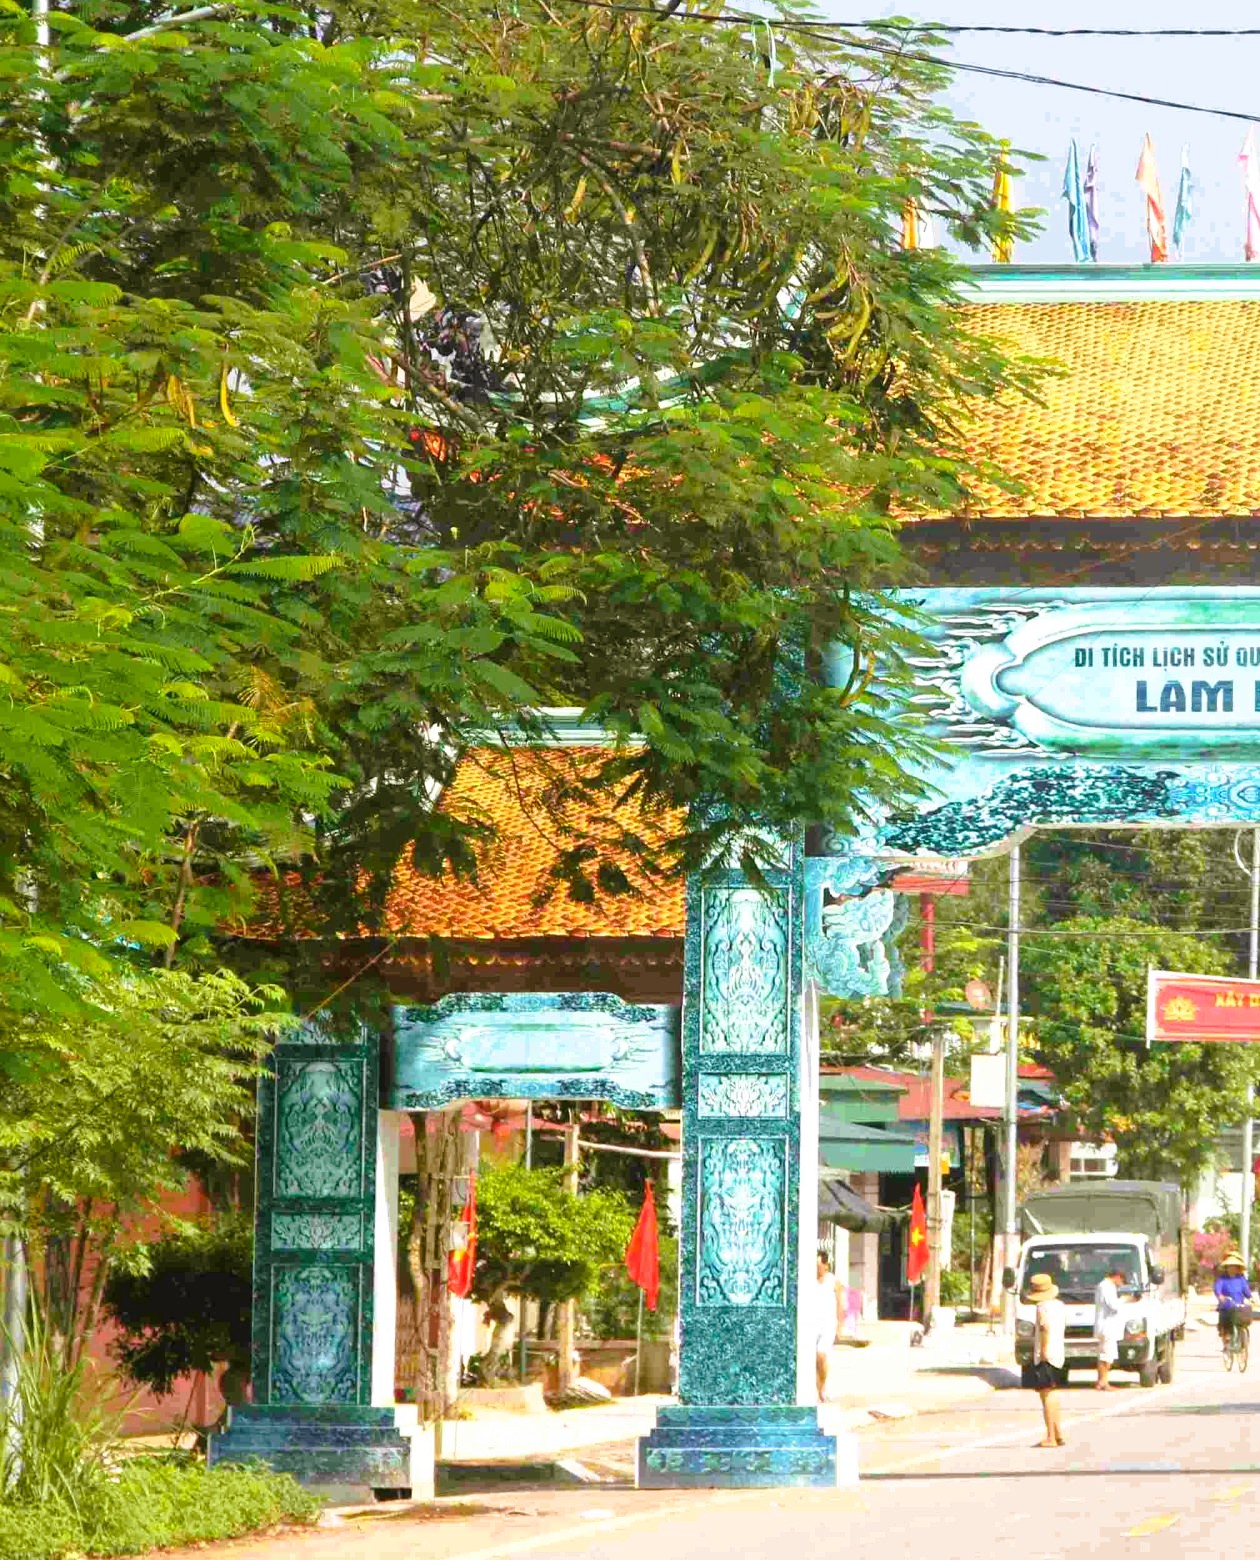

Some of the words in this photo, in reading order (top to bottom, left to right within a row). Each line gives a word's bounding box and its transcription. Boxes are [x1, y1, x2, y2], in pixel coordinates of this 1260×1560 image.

[1075, 648, 1093, 667] DI
[1101, 643, 1144, 667] TÍCH
[1153, 647, 1195, 671] LỊCH
[1203, 641, 1229, 667] SỬ
[1136, 680, 1234, 713] LAM
